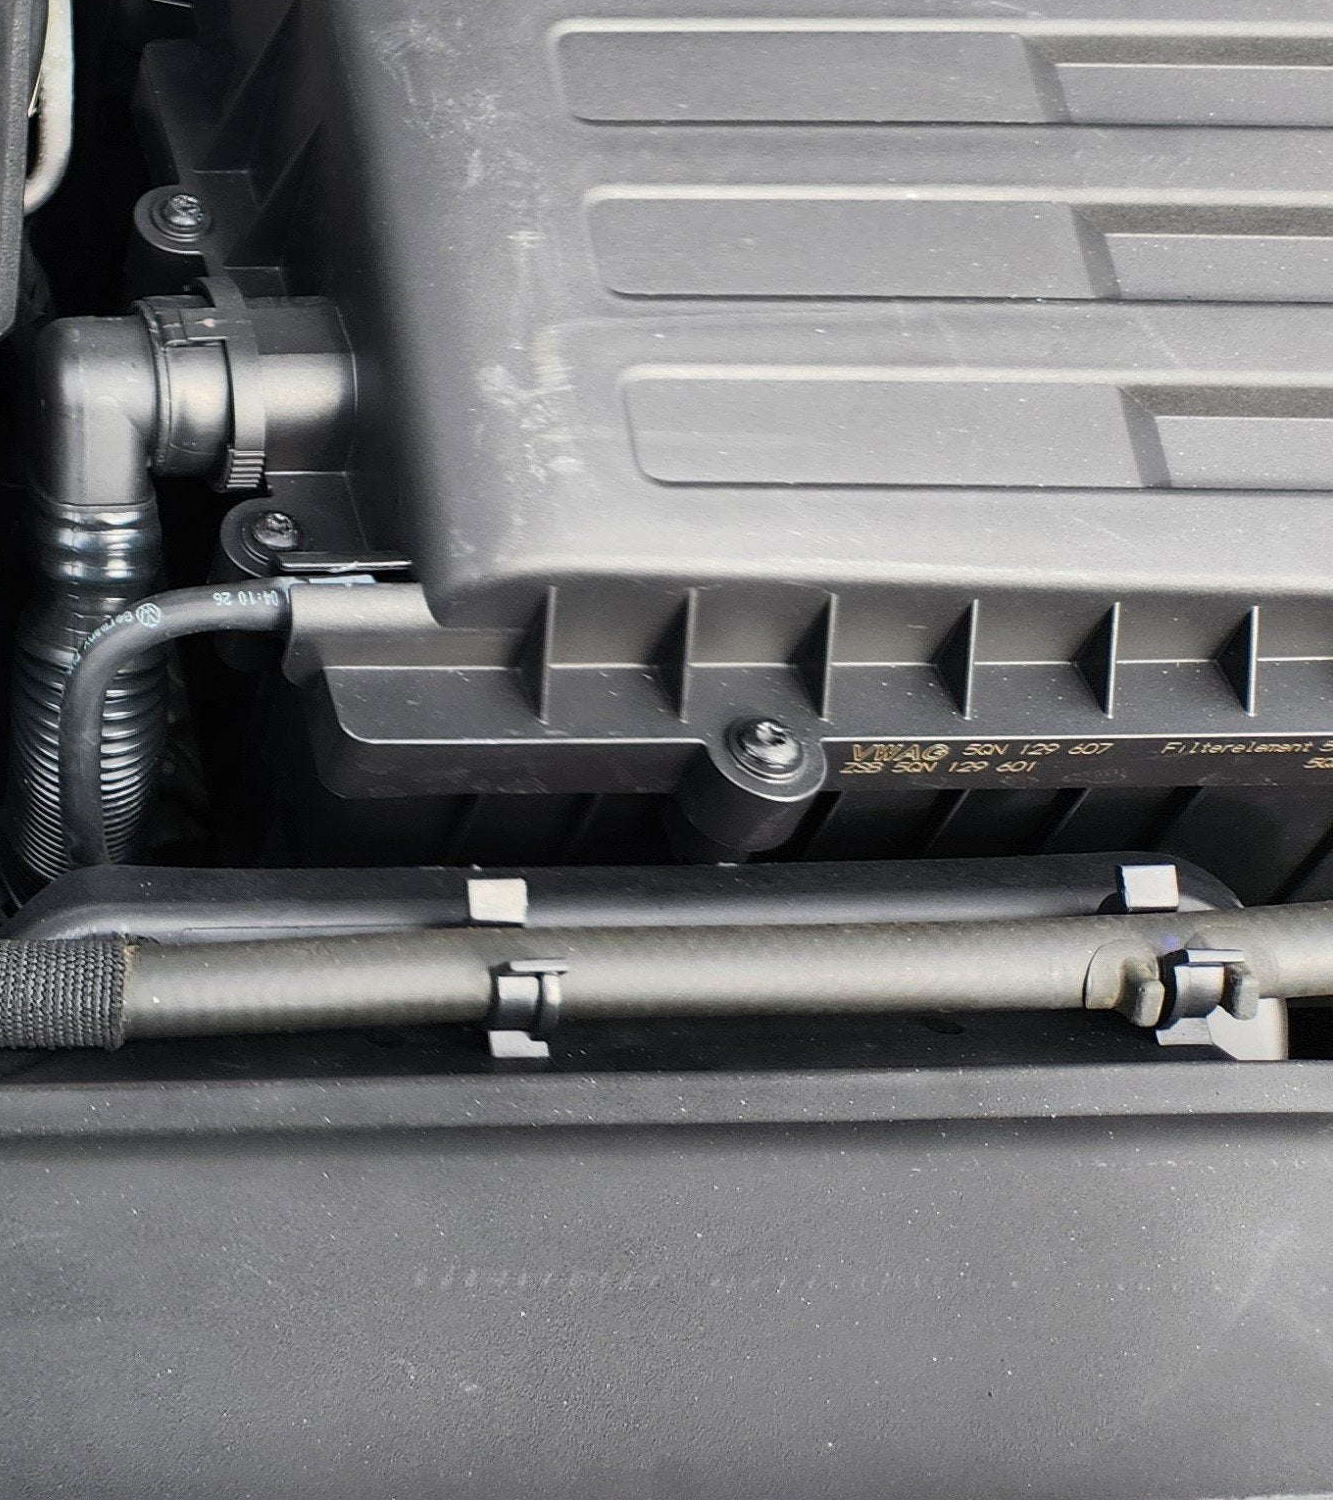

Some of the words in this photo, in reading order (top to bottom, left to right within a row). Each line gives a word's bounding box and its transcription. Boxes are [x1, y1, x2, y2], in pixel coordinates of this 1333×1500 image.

[852, 744, 950, 761] VWAG
[962, 743, 1008, 756] 5QN
[1020, 743, 1060, 755] 129
[1067, 743, 1115, 755] 607
[1160, 741, 1314, 754] Filterelement
[839, 761, 883, 774] ZSB
[892, 761, 937, 773] 5QN
[948, 761, 988, 773] 129
[995, 761, 1038, 773] 601
